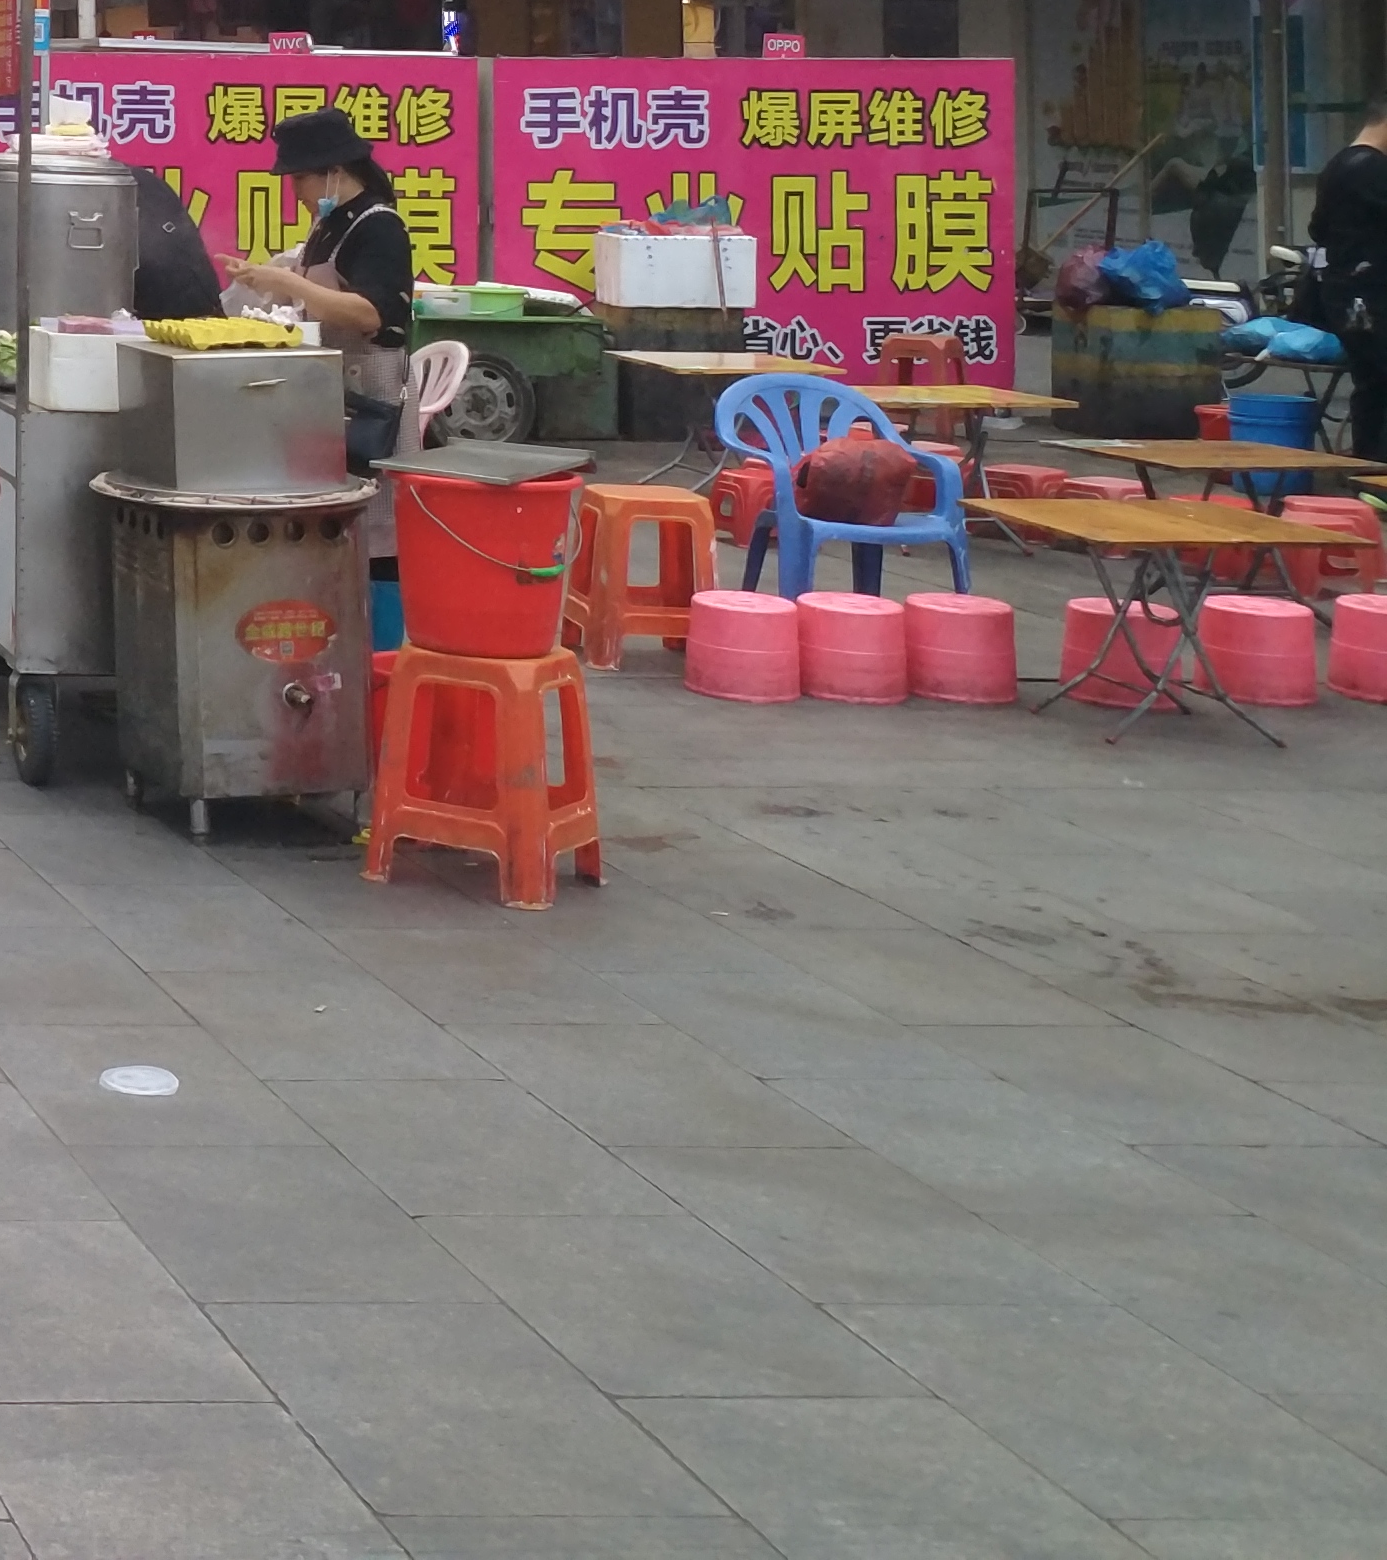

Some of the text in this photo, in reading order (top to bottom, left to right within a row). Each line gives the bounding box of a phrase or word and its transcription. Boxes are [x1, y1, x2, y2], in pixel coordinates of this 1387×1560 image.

[767, 38, 800, 53] OPPO
[208, 84, 452, 145] 爆屏维修
[521, 86, 990, 150] 手机壳 爆屏维修
